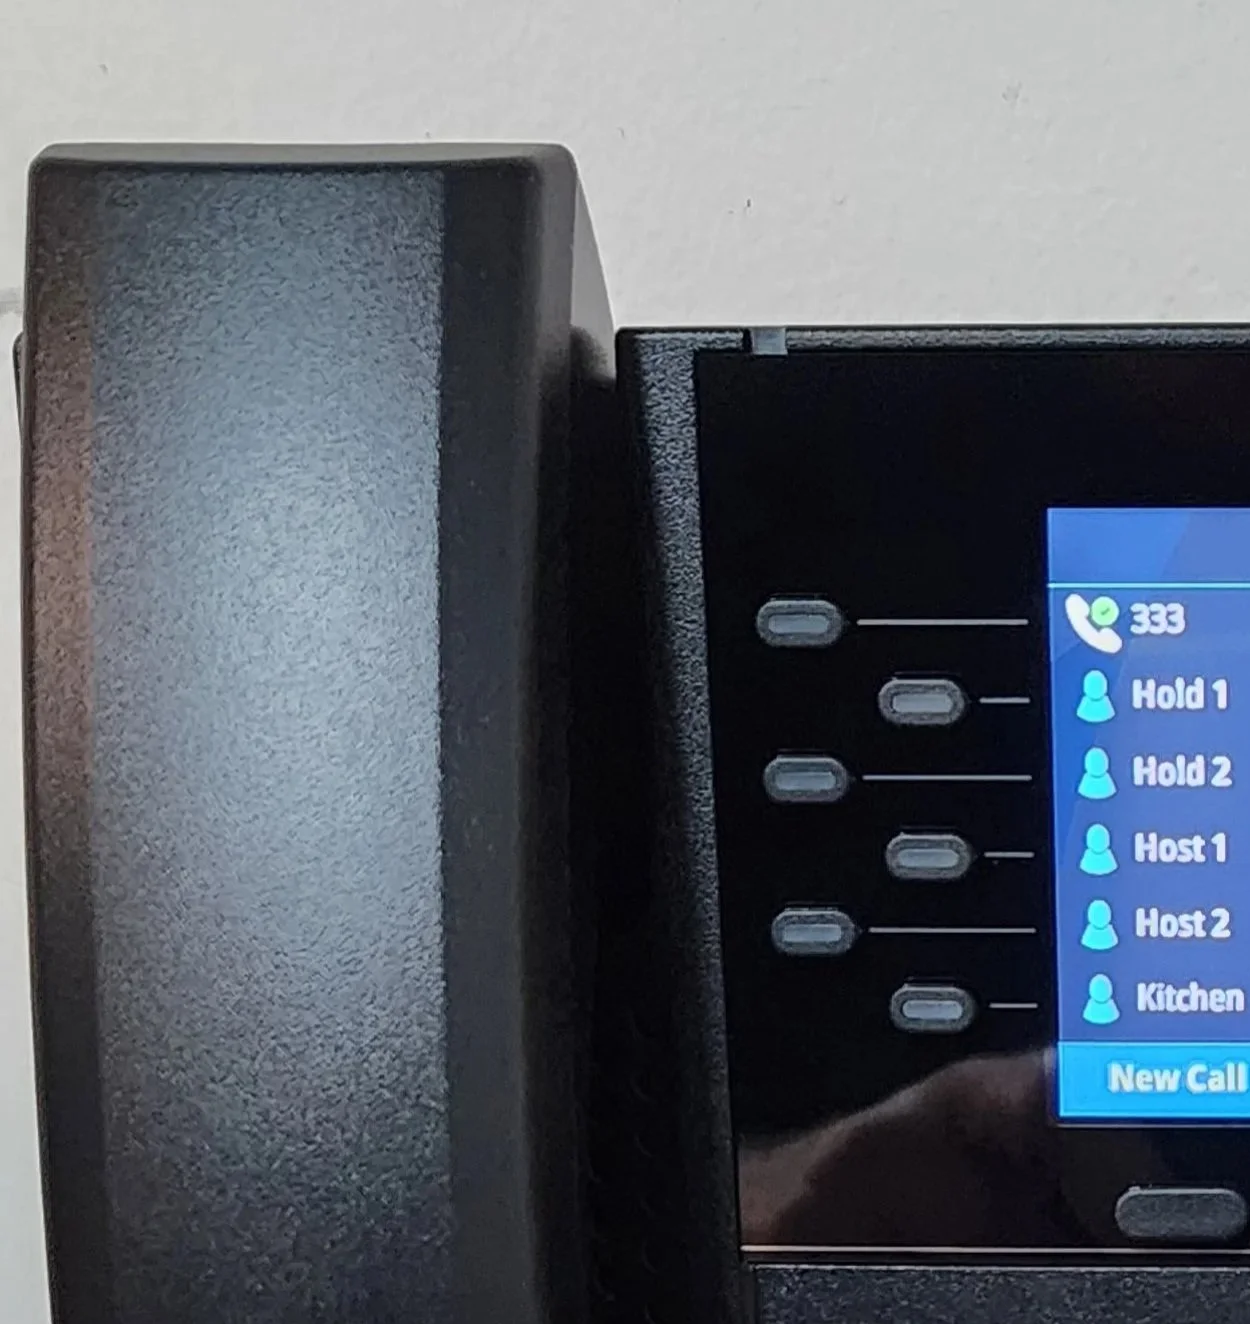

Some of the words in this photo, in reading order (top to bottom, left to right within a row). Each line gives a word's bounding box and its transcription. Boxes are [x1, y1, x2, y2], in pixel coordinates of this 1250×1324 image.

[1130, 602, 1186, 635] 333
[1132, 676, 1205, 710] Hold
[1212, 679, 1228, 709] 1
[1133, 754, 1206, 787] Hold
[1210, 755, 1233, 787] 2
[1134, 832, 1206, 863] Host
[1211, 832, 1226, 863] 1
[1135, 907, 1207, 939] Host
[1210, 907, 1231, 939] 2
[1137, 981, 1245, 1013] Kitchen
[1108, 1063, 1182, 1093] New
[1185, 1062, 1247, 1094] Call
